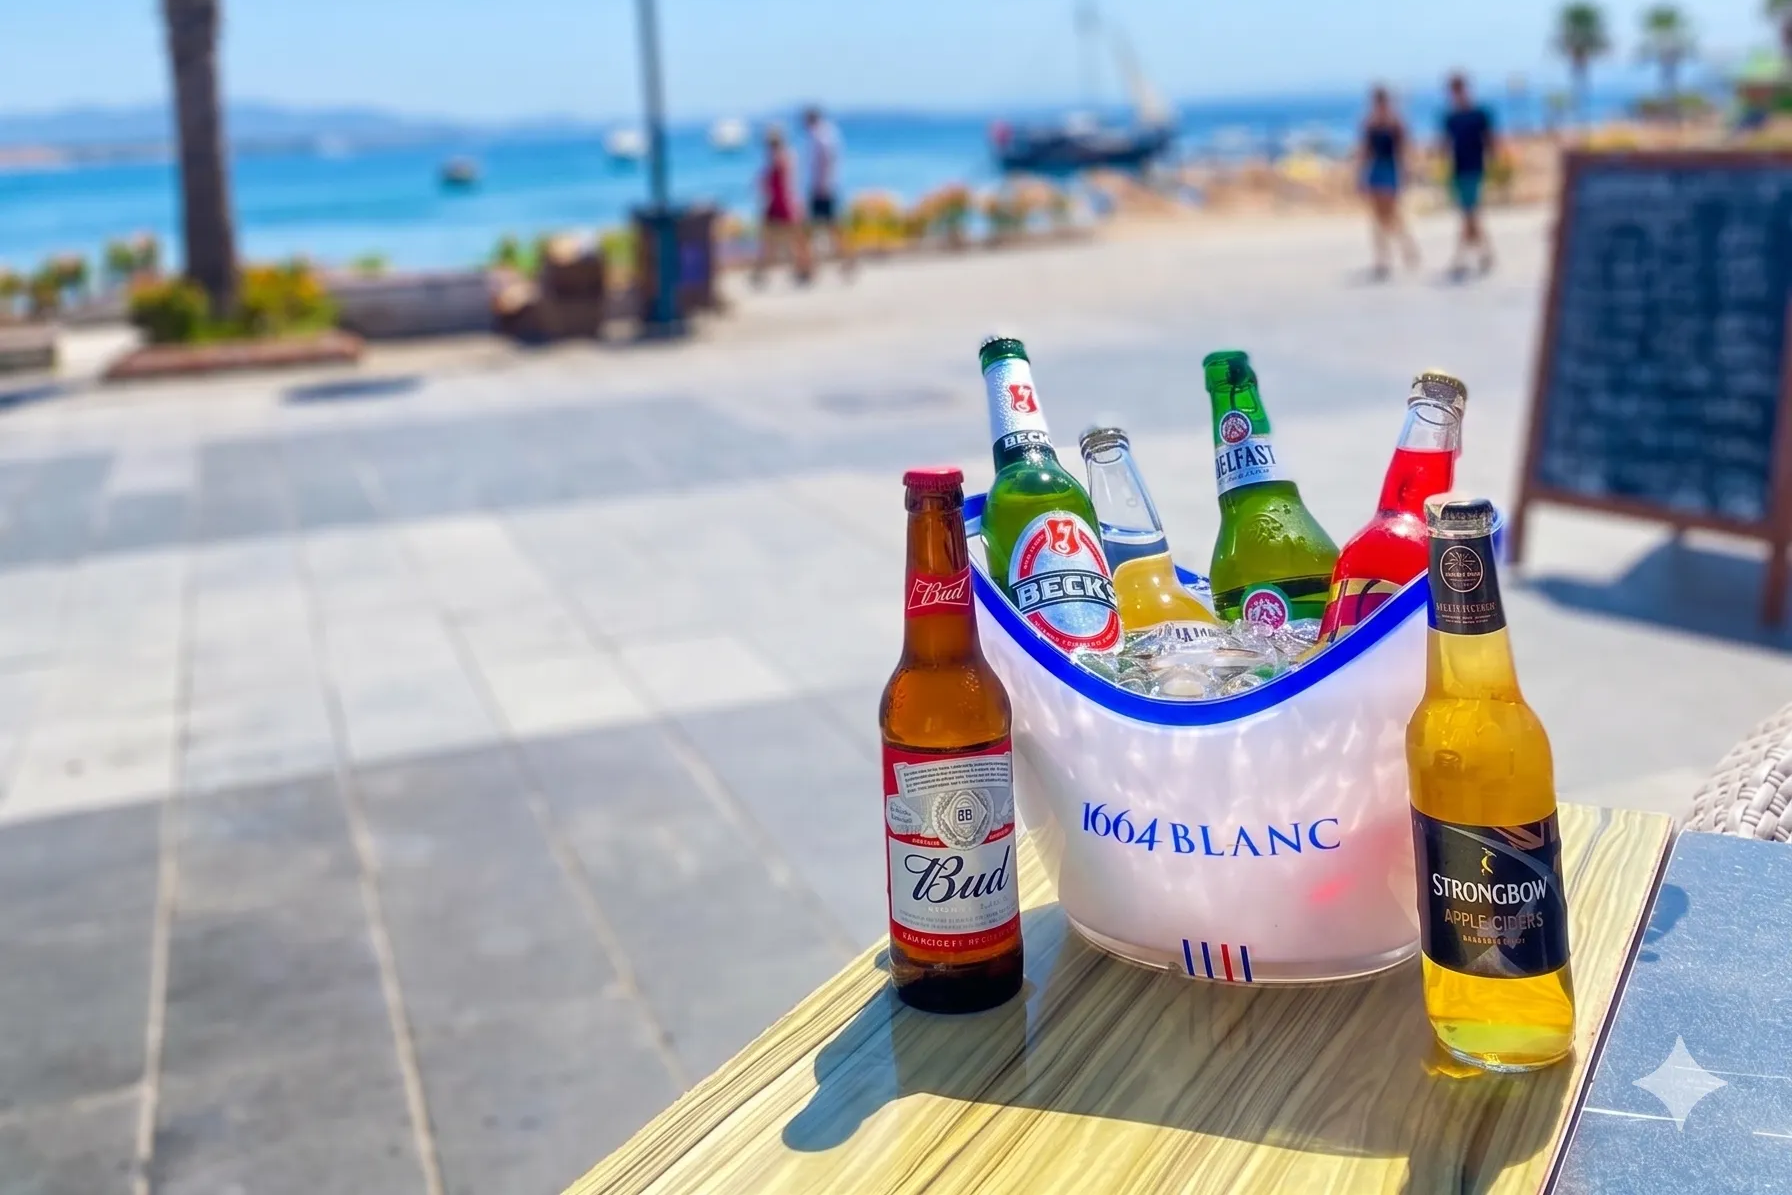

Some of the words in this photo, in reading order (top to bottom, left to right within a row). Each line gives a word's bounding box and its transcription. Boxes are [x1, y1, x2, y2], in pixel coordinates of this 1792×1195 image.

[916, 582, 965, 605] Bud
[1083, 802, 1163, 851] 1664
[1168, 818, 1341, 857] BLANC
[904, 845, 1010, 904] Bud
[1432, 872, 1548, 905] STRONGBOW
[1444, 908, 1489, 931] APPLE
[1491, 911, 1544, 931] CIDERS
